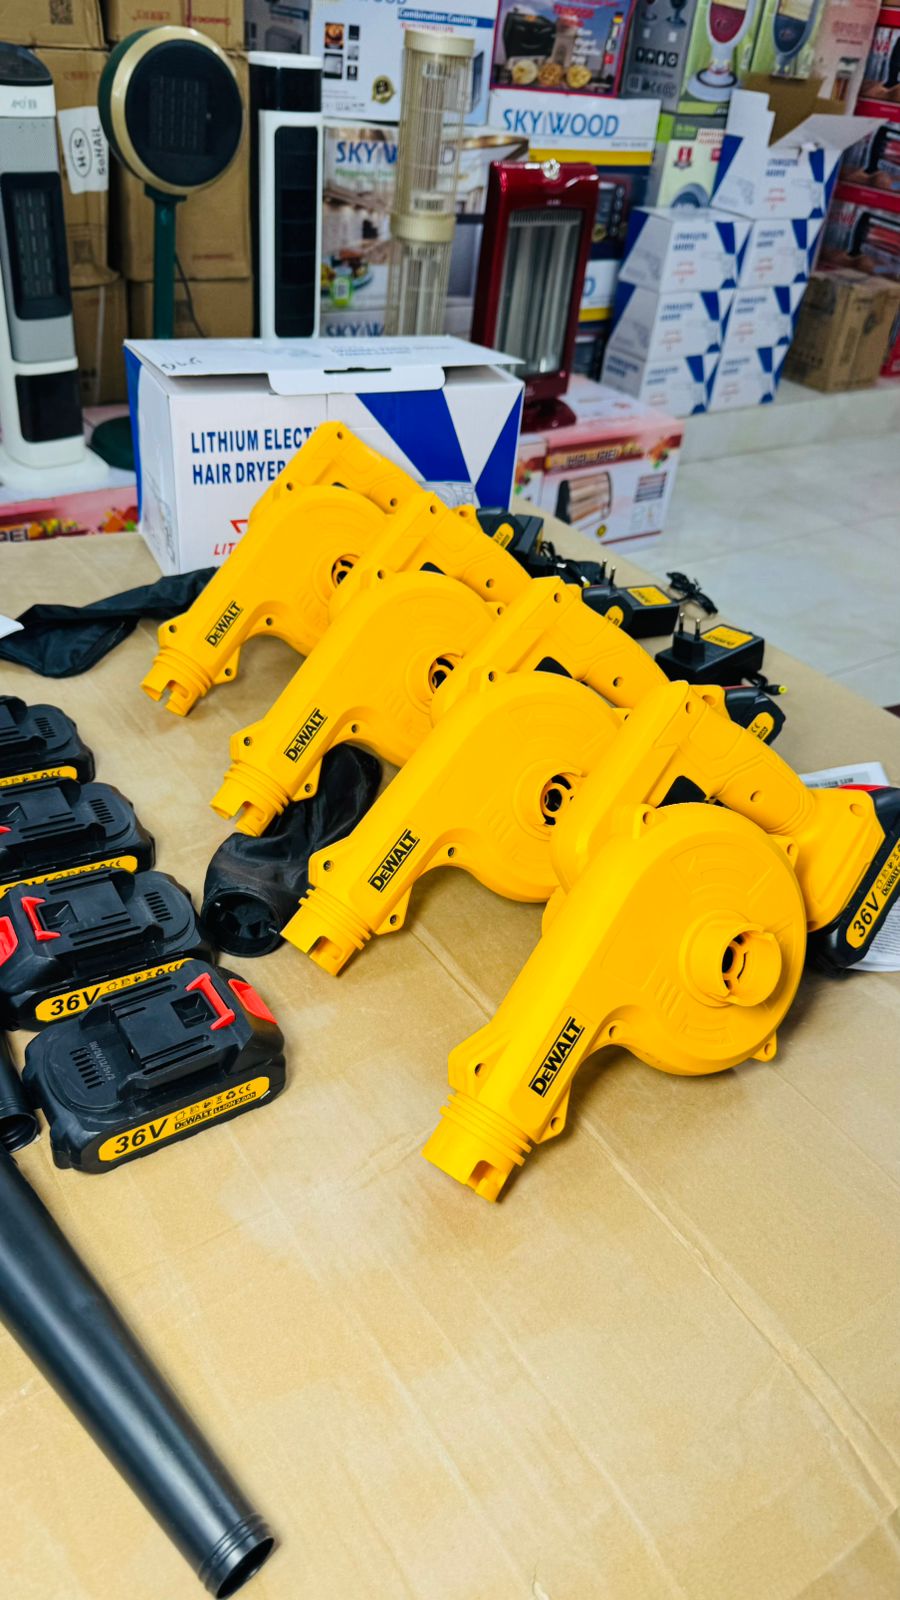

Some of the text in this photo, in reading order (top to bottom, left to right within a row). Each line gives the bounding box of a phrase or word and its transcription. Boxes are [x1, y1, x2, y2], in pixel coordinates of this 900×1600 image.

[191, 426, 317, 454] LITHIUM ELECT
[193, 463, 232, 485] HAIR
[853, 891, 879, 937] 36V
[50, 987, 101, 1016] 36V
[114, 1119, 169, 1154] 36V
